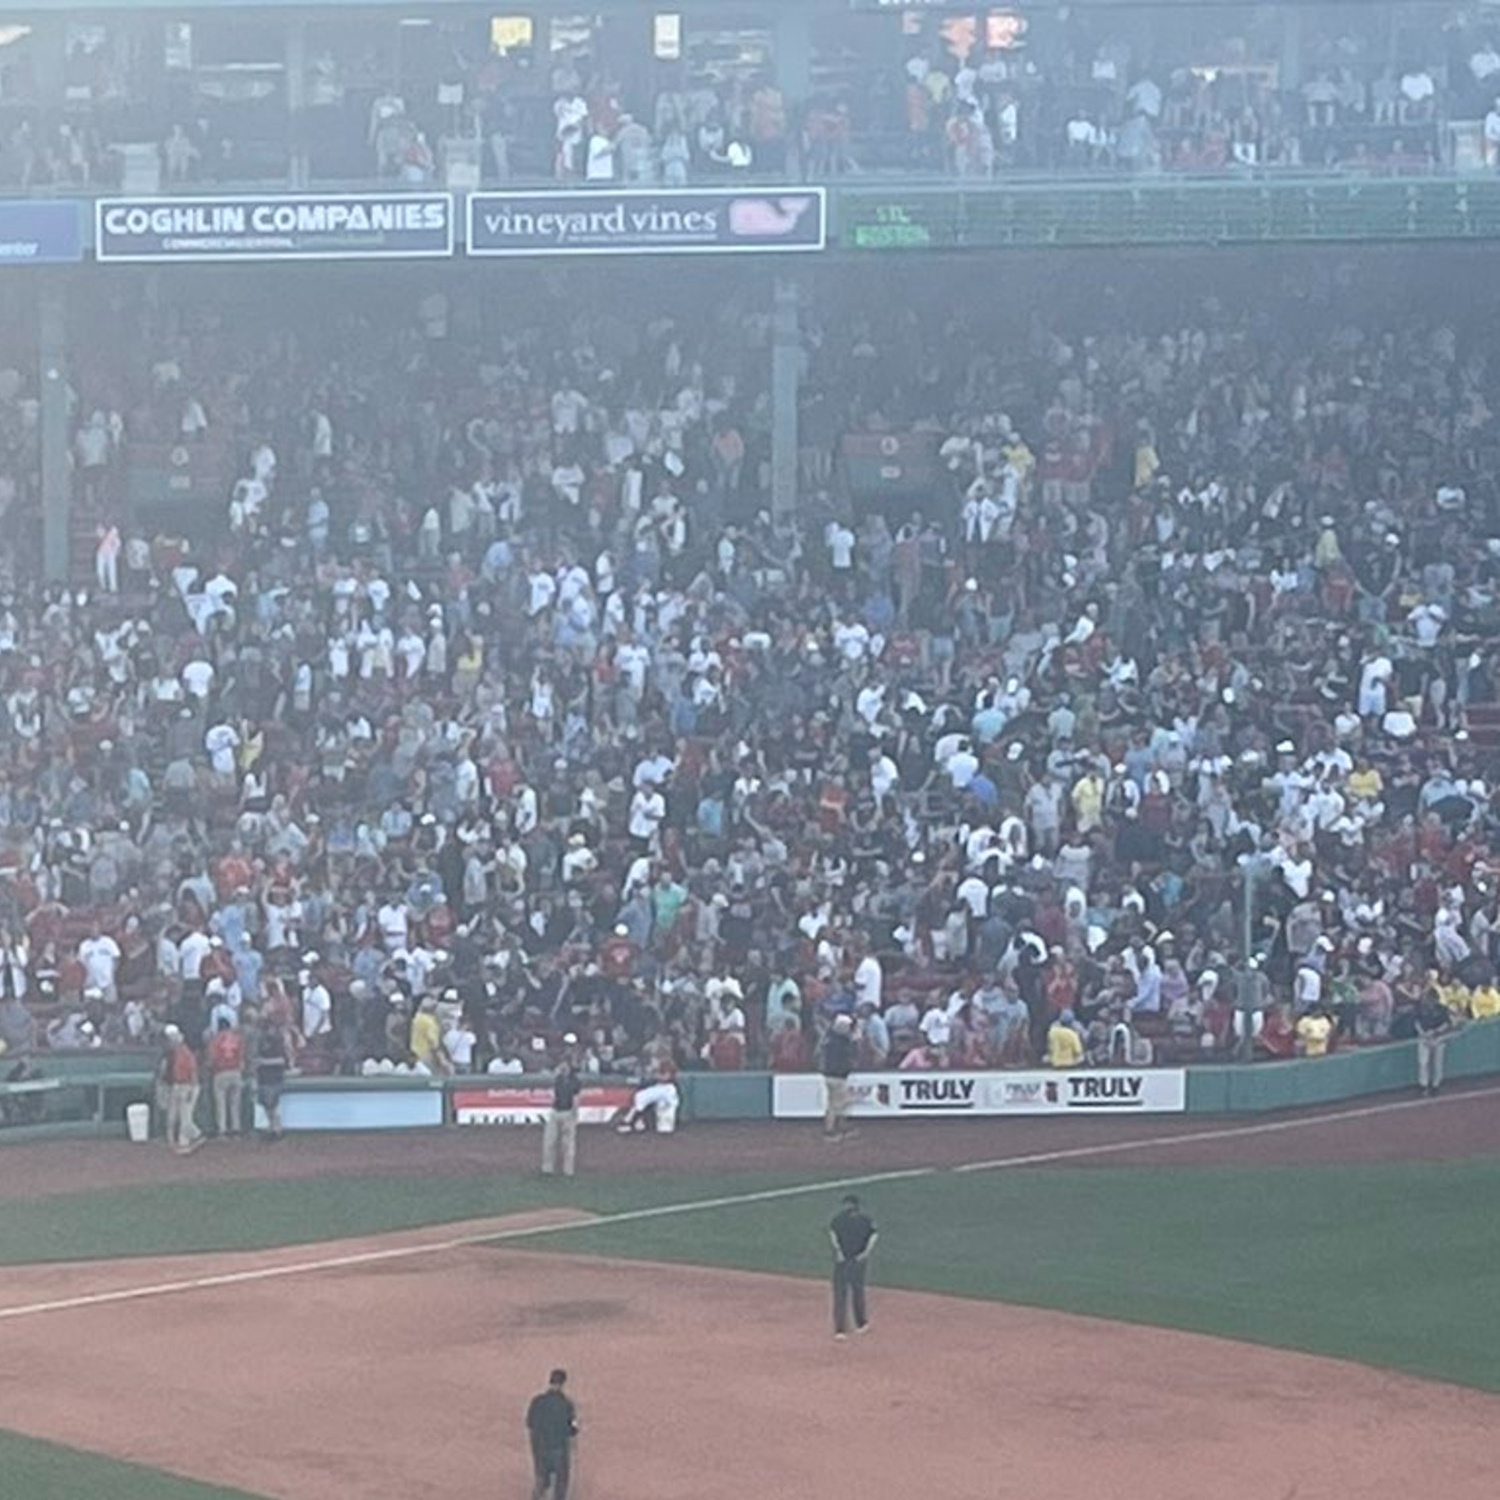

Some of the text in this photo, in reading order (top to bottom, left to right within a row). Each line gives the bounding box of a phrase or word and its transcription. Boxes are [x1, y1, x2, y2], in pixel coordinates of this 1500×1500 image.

[104, 203, 446, 235] COGHLIN COMPANIES
[484, 204, 718, 243] vineyard vines
[899, 1079, 975, 1100] TRULY
[1067, 1076, 1143, 1098] TRULY
